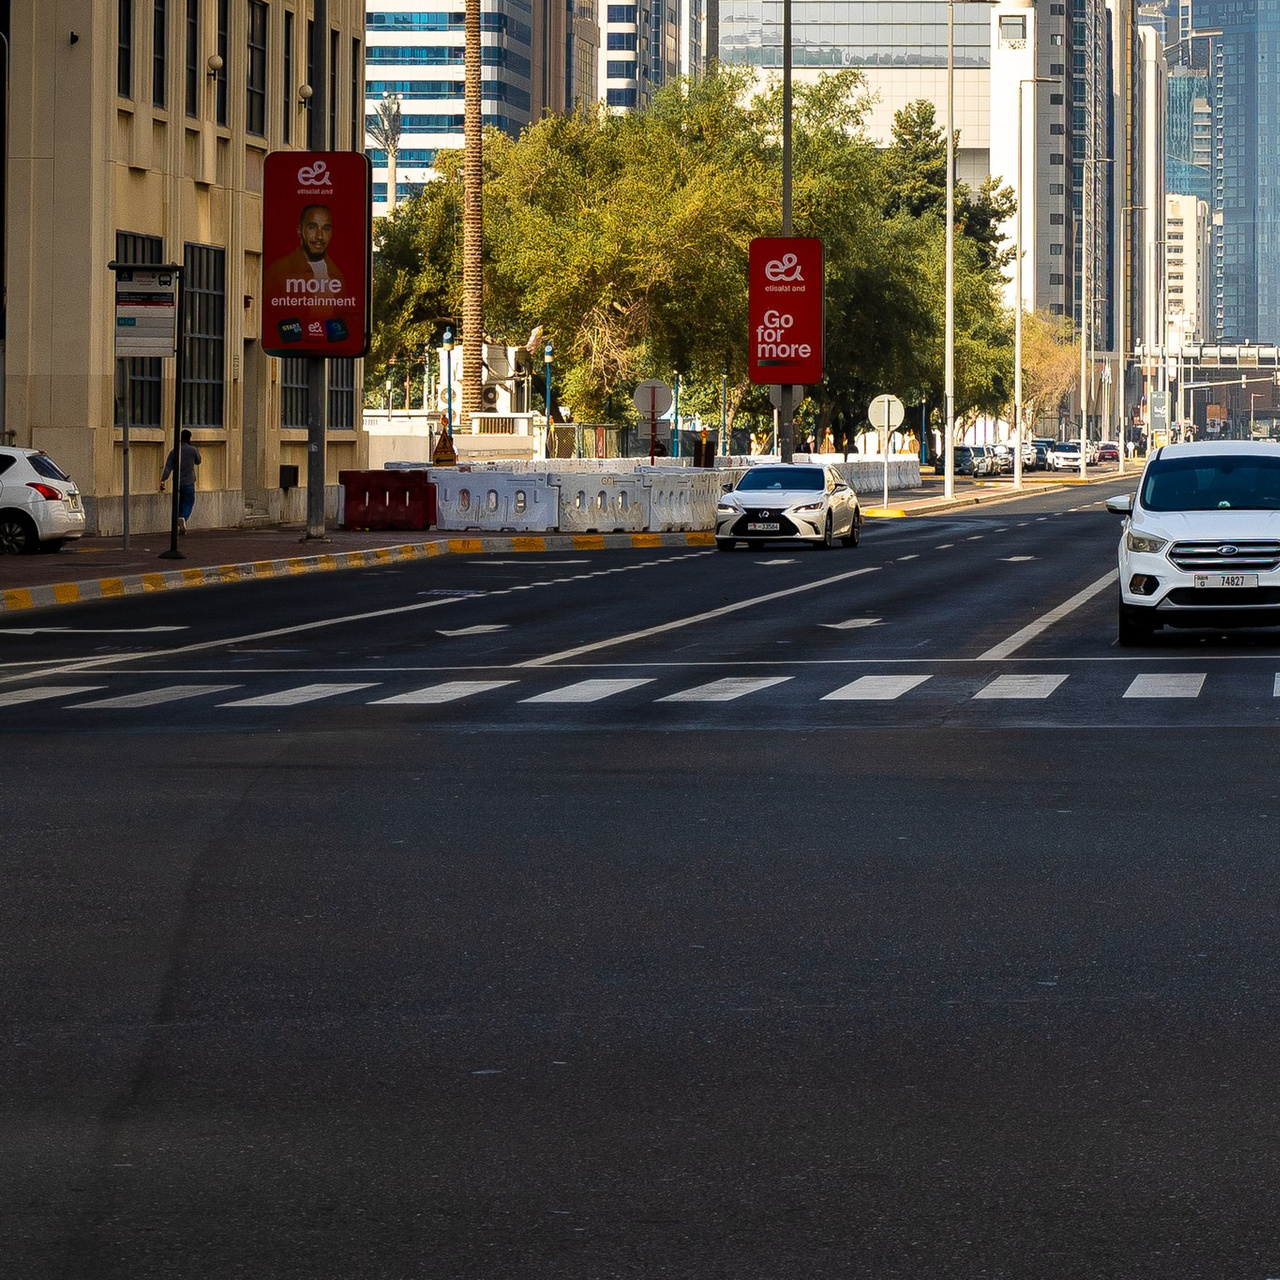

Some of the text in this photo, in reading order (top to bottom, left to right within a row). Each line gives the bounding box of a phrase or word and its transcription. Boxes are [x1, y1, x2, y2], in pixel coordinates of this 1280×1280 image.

[286, 278, 341, 293] more
[271, 295, 356, 307] entertainment
[763, 310, 794, 328] Go
[756, 325, 785, 342] for
[757, 343, 811, 358] more
[1221, 576, 1244, 586] 74827
